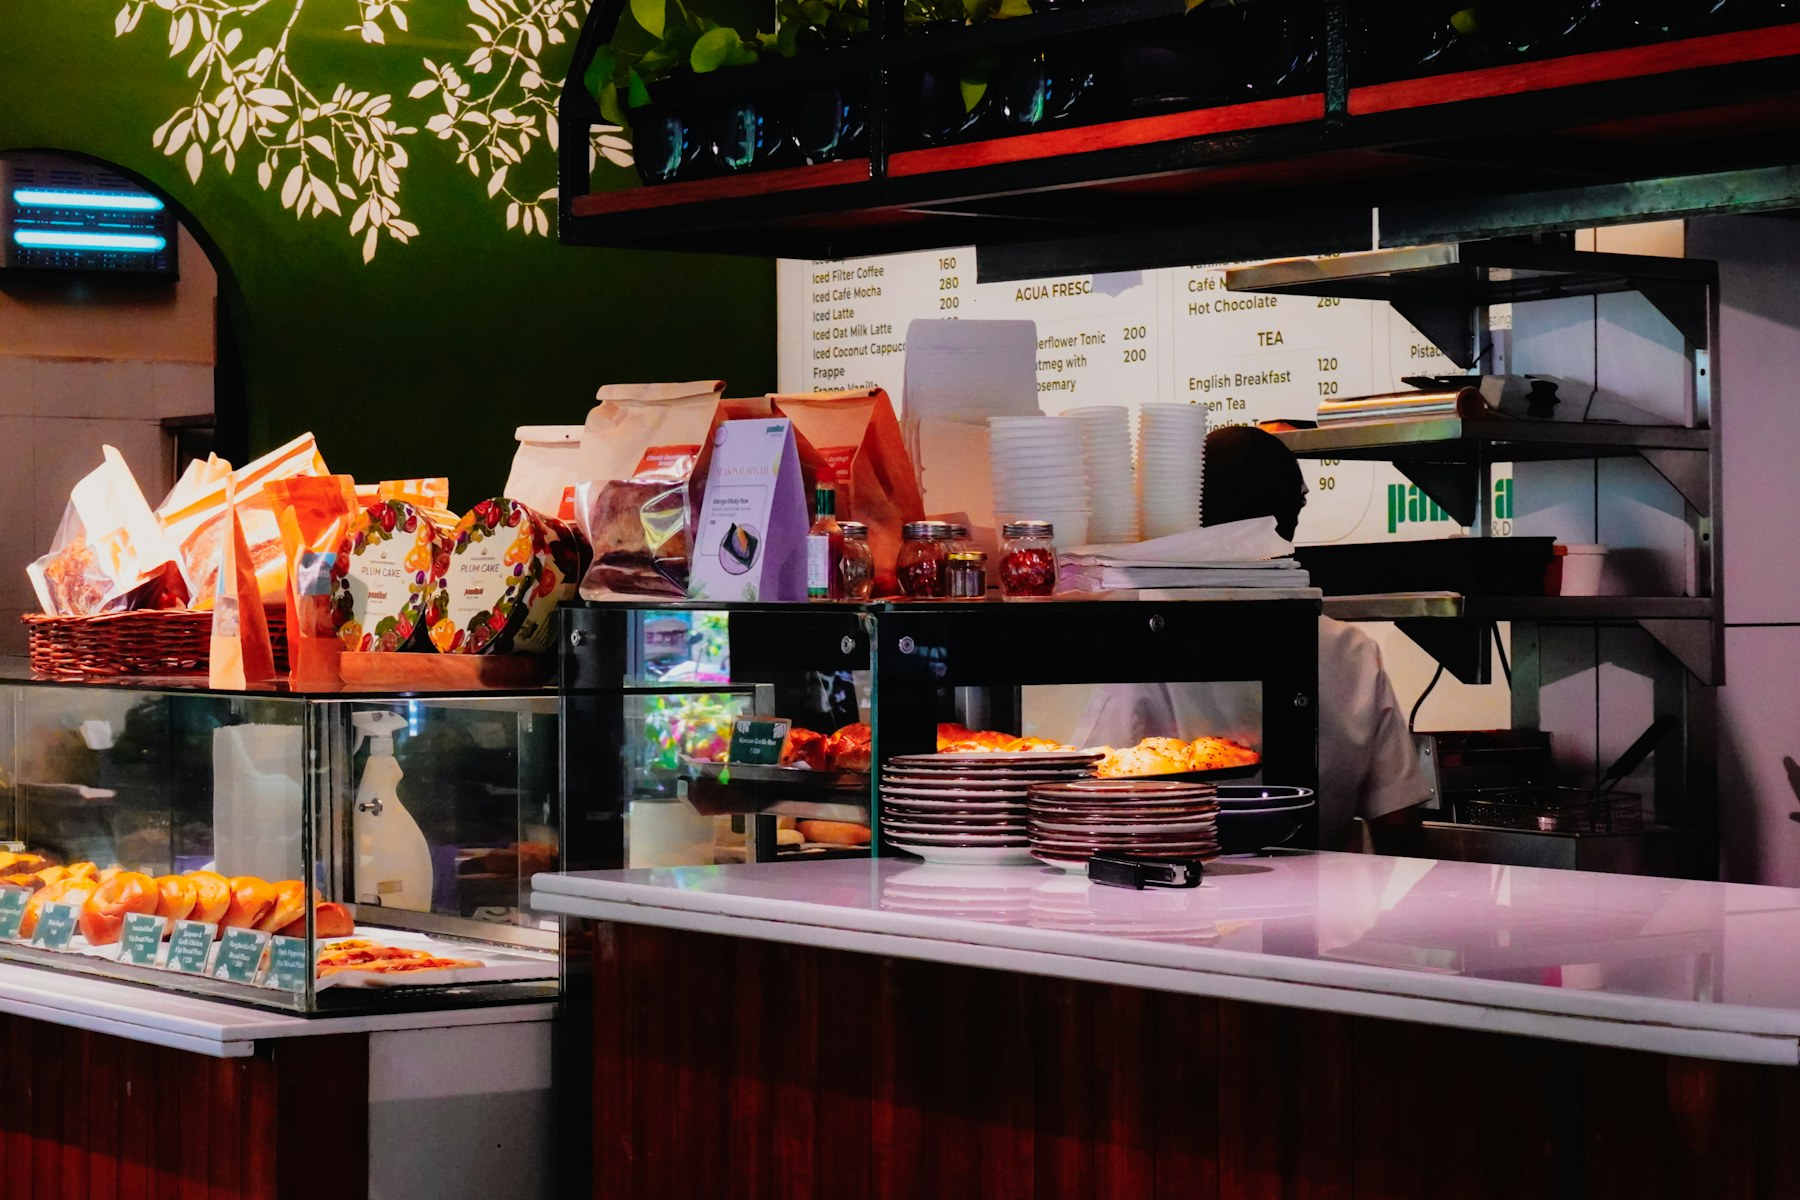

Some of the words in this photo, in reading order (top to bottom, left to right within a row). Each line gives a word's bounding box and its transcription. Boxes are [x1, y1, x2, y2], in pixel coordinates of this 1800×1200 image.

[938, 257, 957, 270] 160
[812, 272, 830, 285] Iced
[832, 269, 855, 282] Filter
[857, 265, 885, 279] Coffee
[939, 276, 959, 291] 280
[1015, 285, 1050, 302] AGUA
[1052, 280, 1093, 298] FRESC
[1188, 276, 1216, 293] Café
[812, 289, 830, 303] Iced
[832, 287, 852, 301] Café
[854, 284, 882, 299] Mocha
[939, 296, 960, 310] 200
[1188, 302, 1211, 316] Hot
[1214, 295, 1278, 313] Chocolate
[812, 309, 831, 322] Iced
[832, 308, 855, 321] Latte
[812, 328, 831, 341] Iced
[832, 327, 848, 339] Oat
[850, 324, 868, 337] Milk
[870, 323, 893, 336] Latte
[1123, 326, 1147, 341] 200
[1257, 330, 1284, 347] TEA
[1036, 335, 1078, 350] erflower
[1080, 330, 1107, 346] Tonic
[812, 347, 831, 360] Iced
[832, 344, 869, 358] Coconut
[1123, 348, 1147, 363] 200
[1410, 343, 1444, 359] Pistac
[1066, 354, 1087, 369] with
[1317, 357, 1338, 372] 120
[813, 367, 846, 380] Frappe
[1188, 374, 1231, 393] English
[1235, 369, 1292, 387] Breakfast
[1037, 378, 1077, 393] osemary
[1317, 381, 1339, 396] 120
[1226, 397, 1246, 411] Tea
[1319, 476, 1336, 491] 90
[361, 566, 381, 577] PLUM
[382, 568, 401, 578] CAKE
[460, 564, 481, 573] PLUM
[481, 563, 501, 573] CAKE
